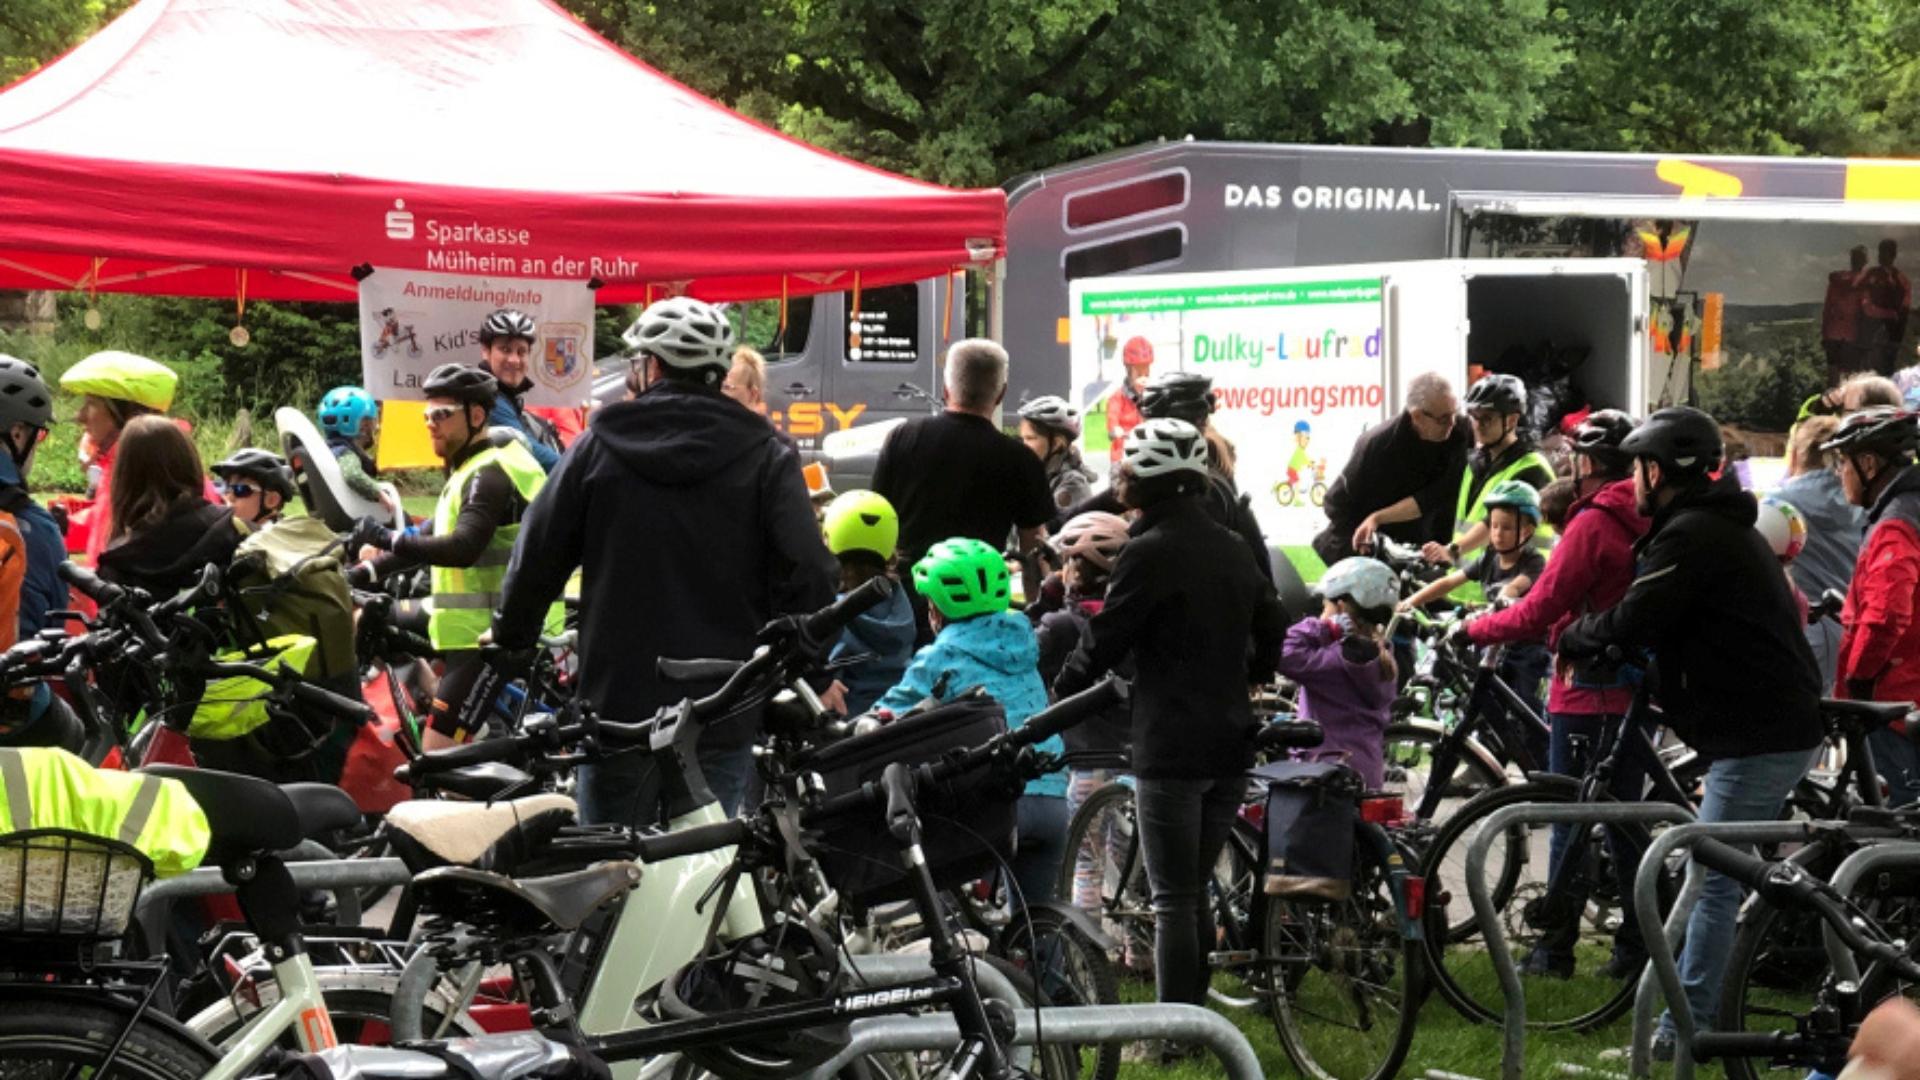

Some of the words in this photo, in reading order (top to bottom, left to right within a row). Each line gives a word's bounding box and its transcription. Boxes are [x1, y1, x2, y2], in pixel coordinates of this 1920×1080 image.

[1224, 184, 1282, 210] DAS
[1293, 185, 1441, 212] ORIGINAL.
[426, 219, 530, 245] Sparkasse
[427, 249, 516, 273] Mülheim
[521, 258, 546, 275] an
[552, 256, 585, 277] der
[590, 256, 639, 277] Ruhr
[1193, 327, 1383, 368] Dulky-Laufrad
[1213, 384, 1384, 416] ewegungsmo
